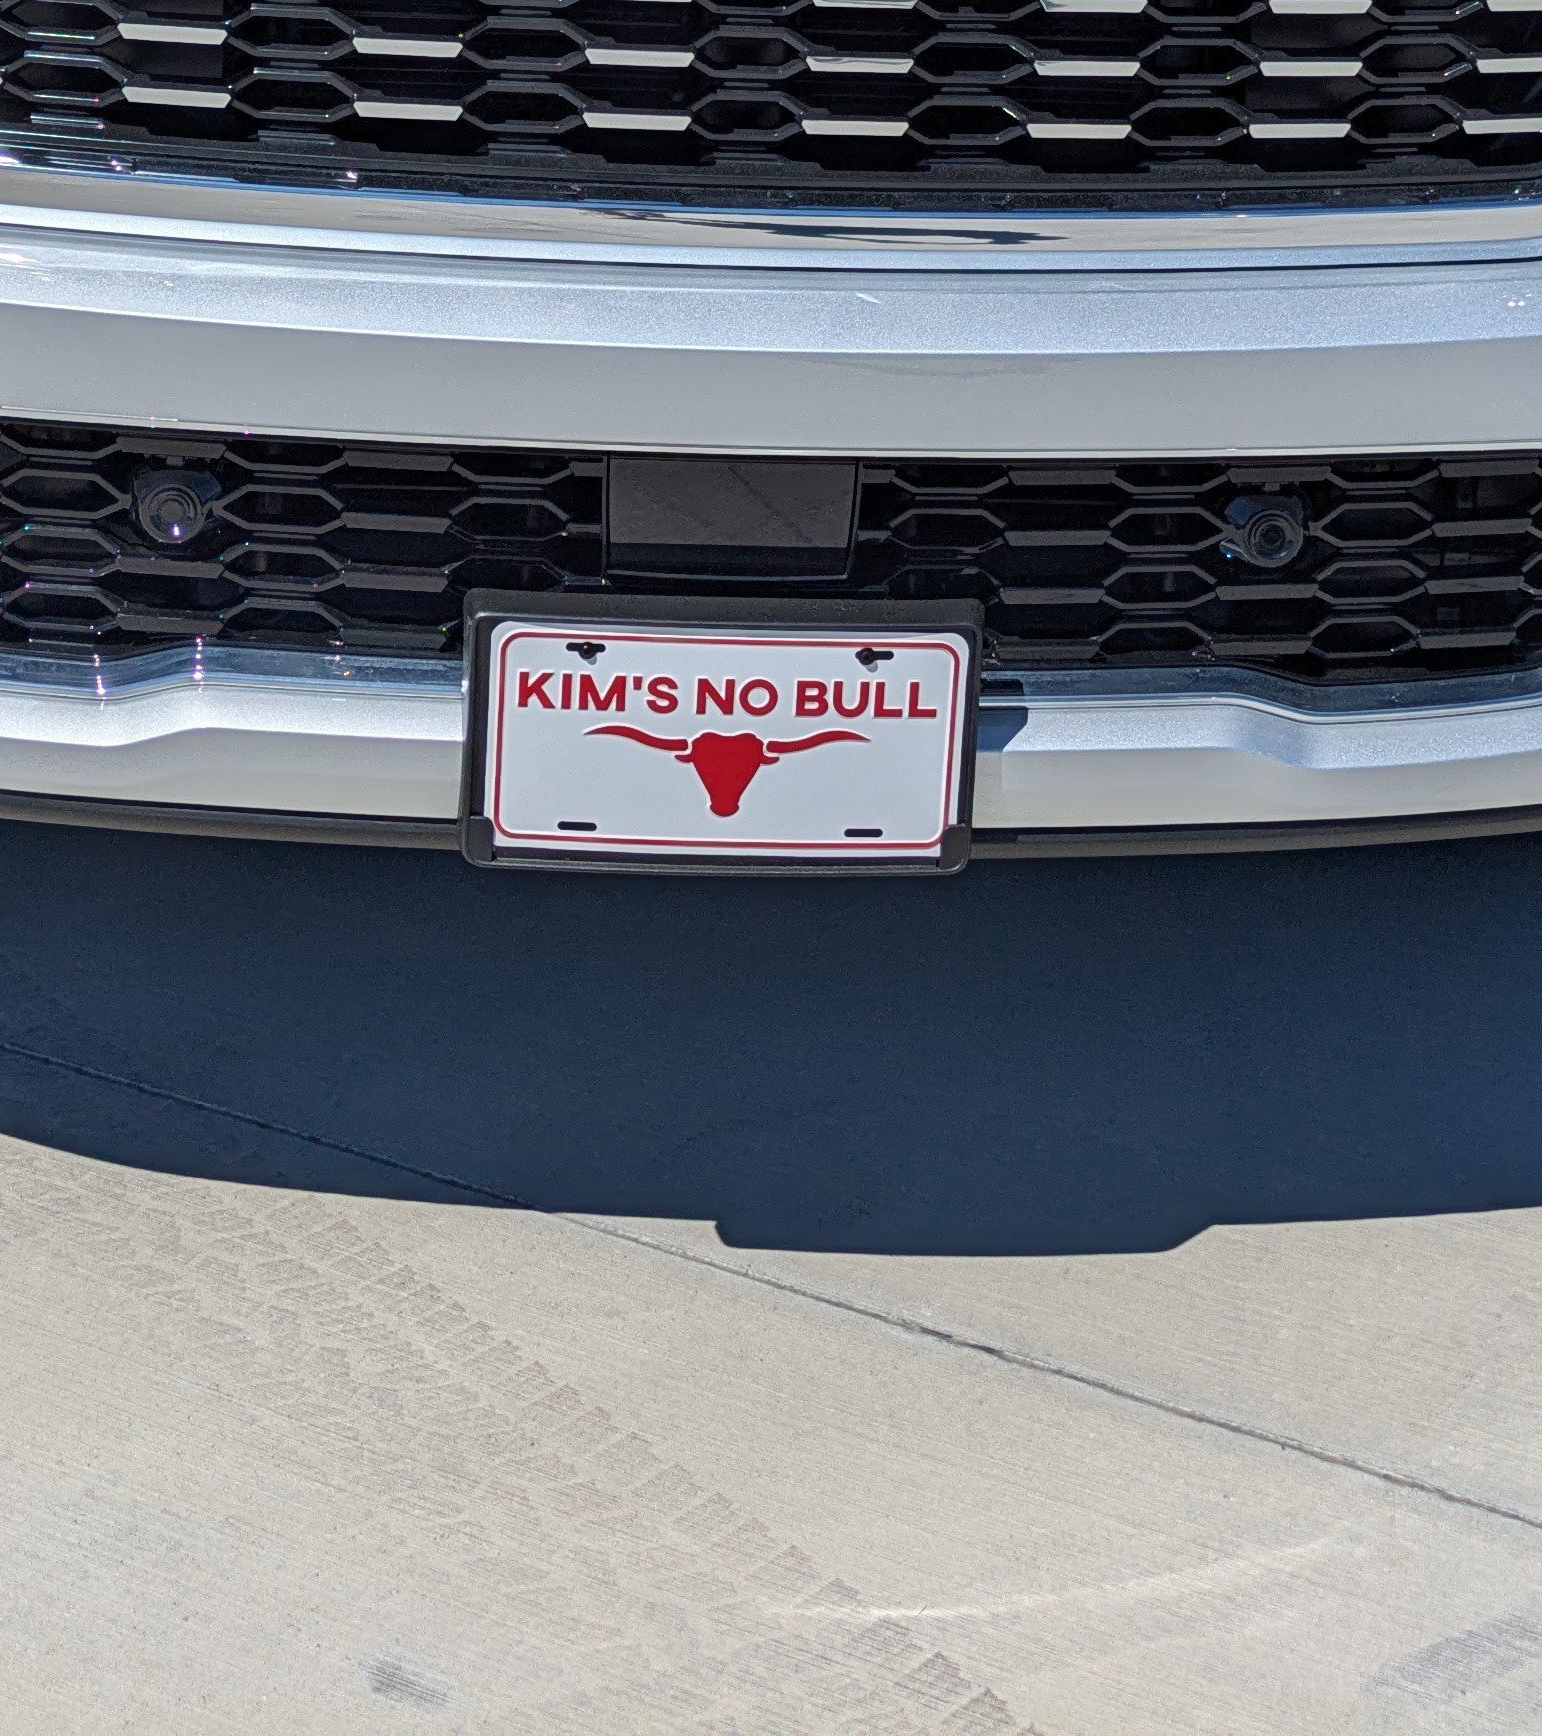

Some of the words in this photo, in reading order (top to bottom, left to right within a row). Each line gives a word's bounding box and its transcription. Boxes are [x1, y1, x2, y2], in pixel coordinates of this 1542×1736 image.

[516, 670, 680, 715] KIM'S
[695, 677, 779, 717] NO
[794, 678, 938, 719] BULL
